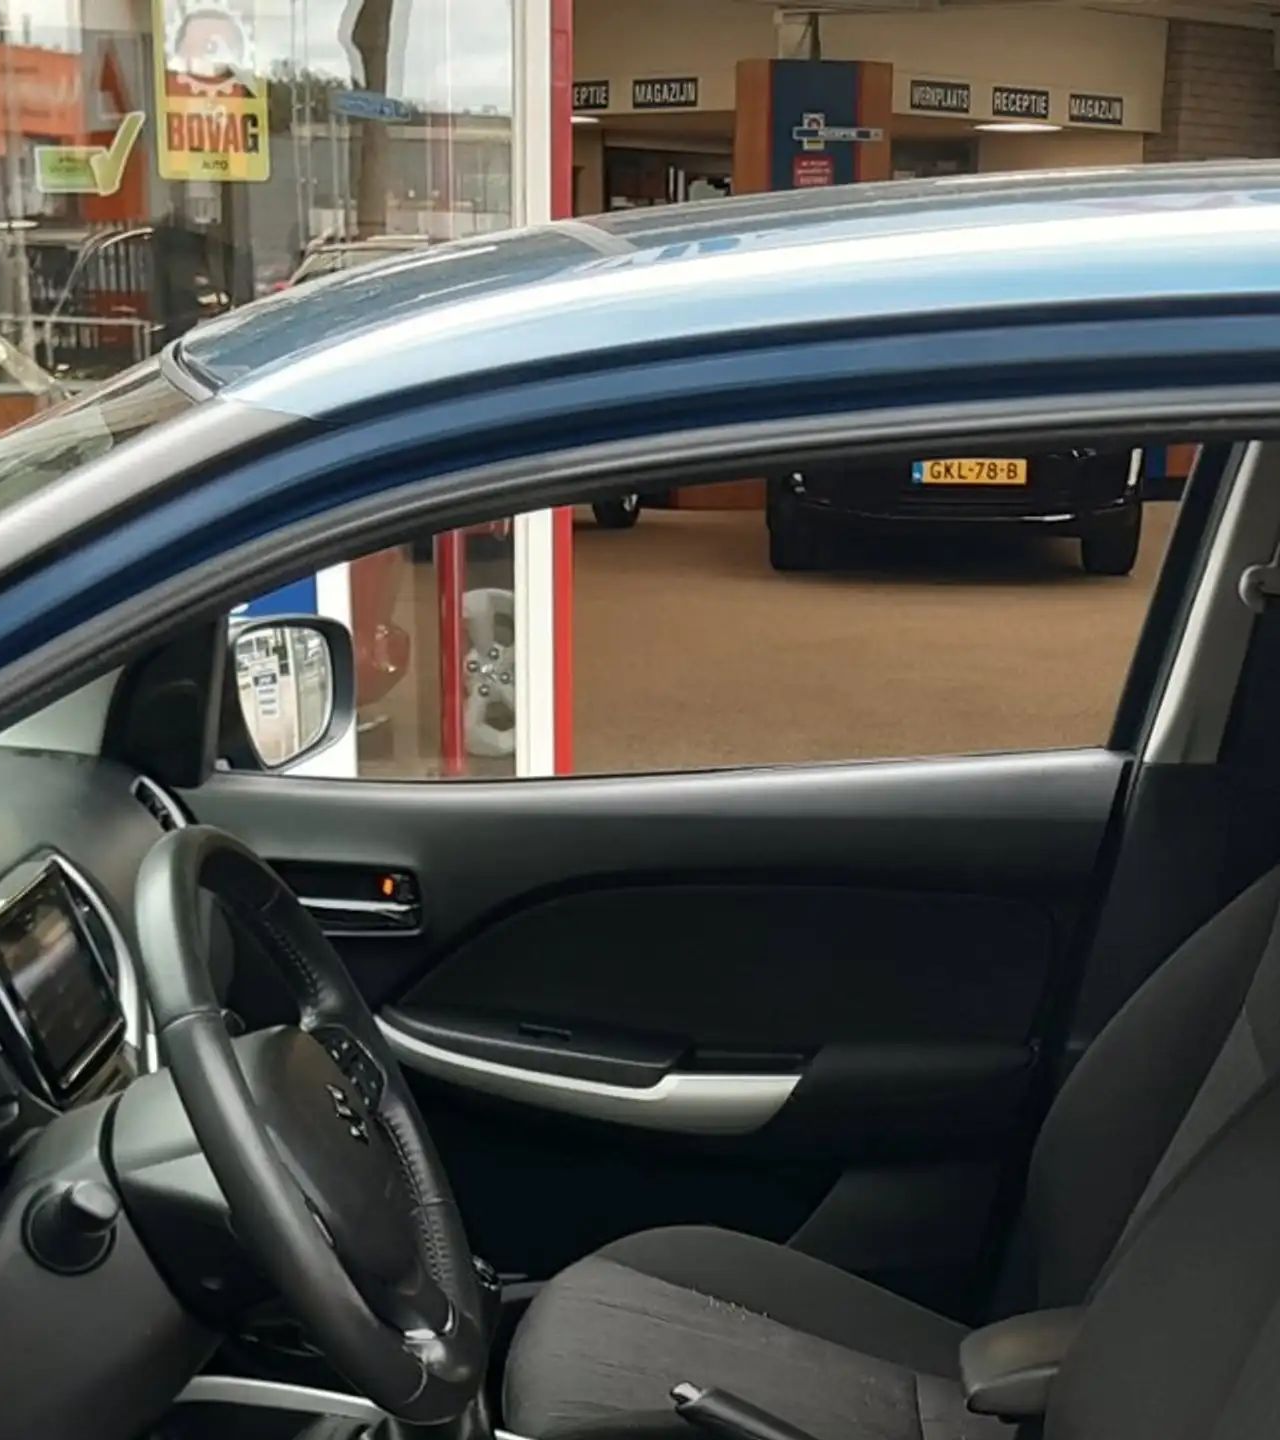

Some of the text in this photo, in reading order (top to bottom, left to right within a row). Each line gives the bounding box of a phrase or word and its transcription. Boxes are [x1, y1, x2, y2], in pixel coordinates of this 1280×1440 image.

[574, 84, 608, 107] EPTIE
[635, 81, 696, 103] MAGAZIJN
[994, 91, 1047, 115] RECEPTIE
[166, 111, 259, 155] BOVAG
[929, 461, 1019, 480] GKL-78-B
